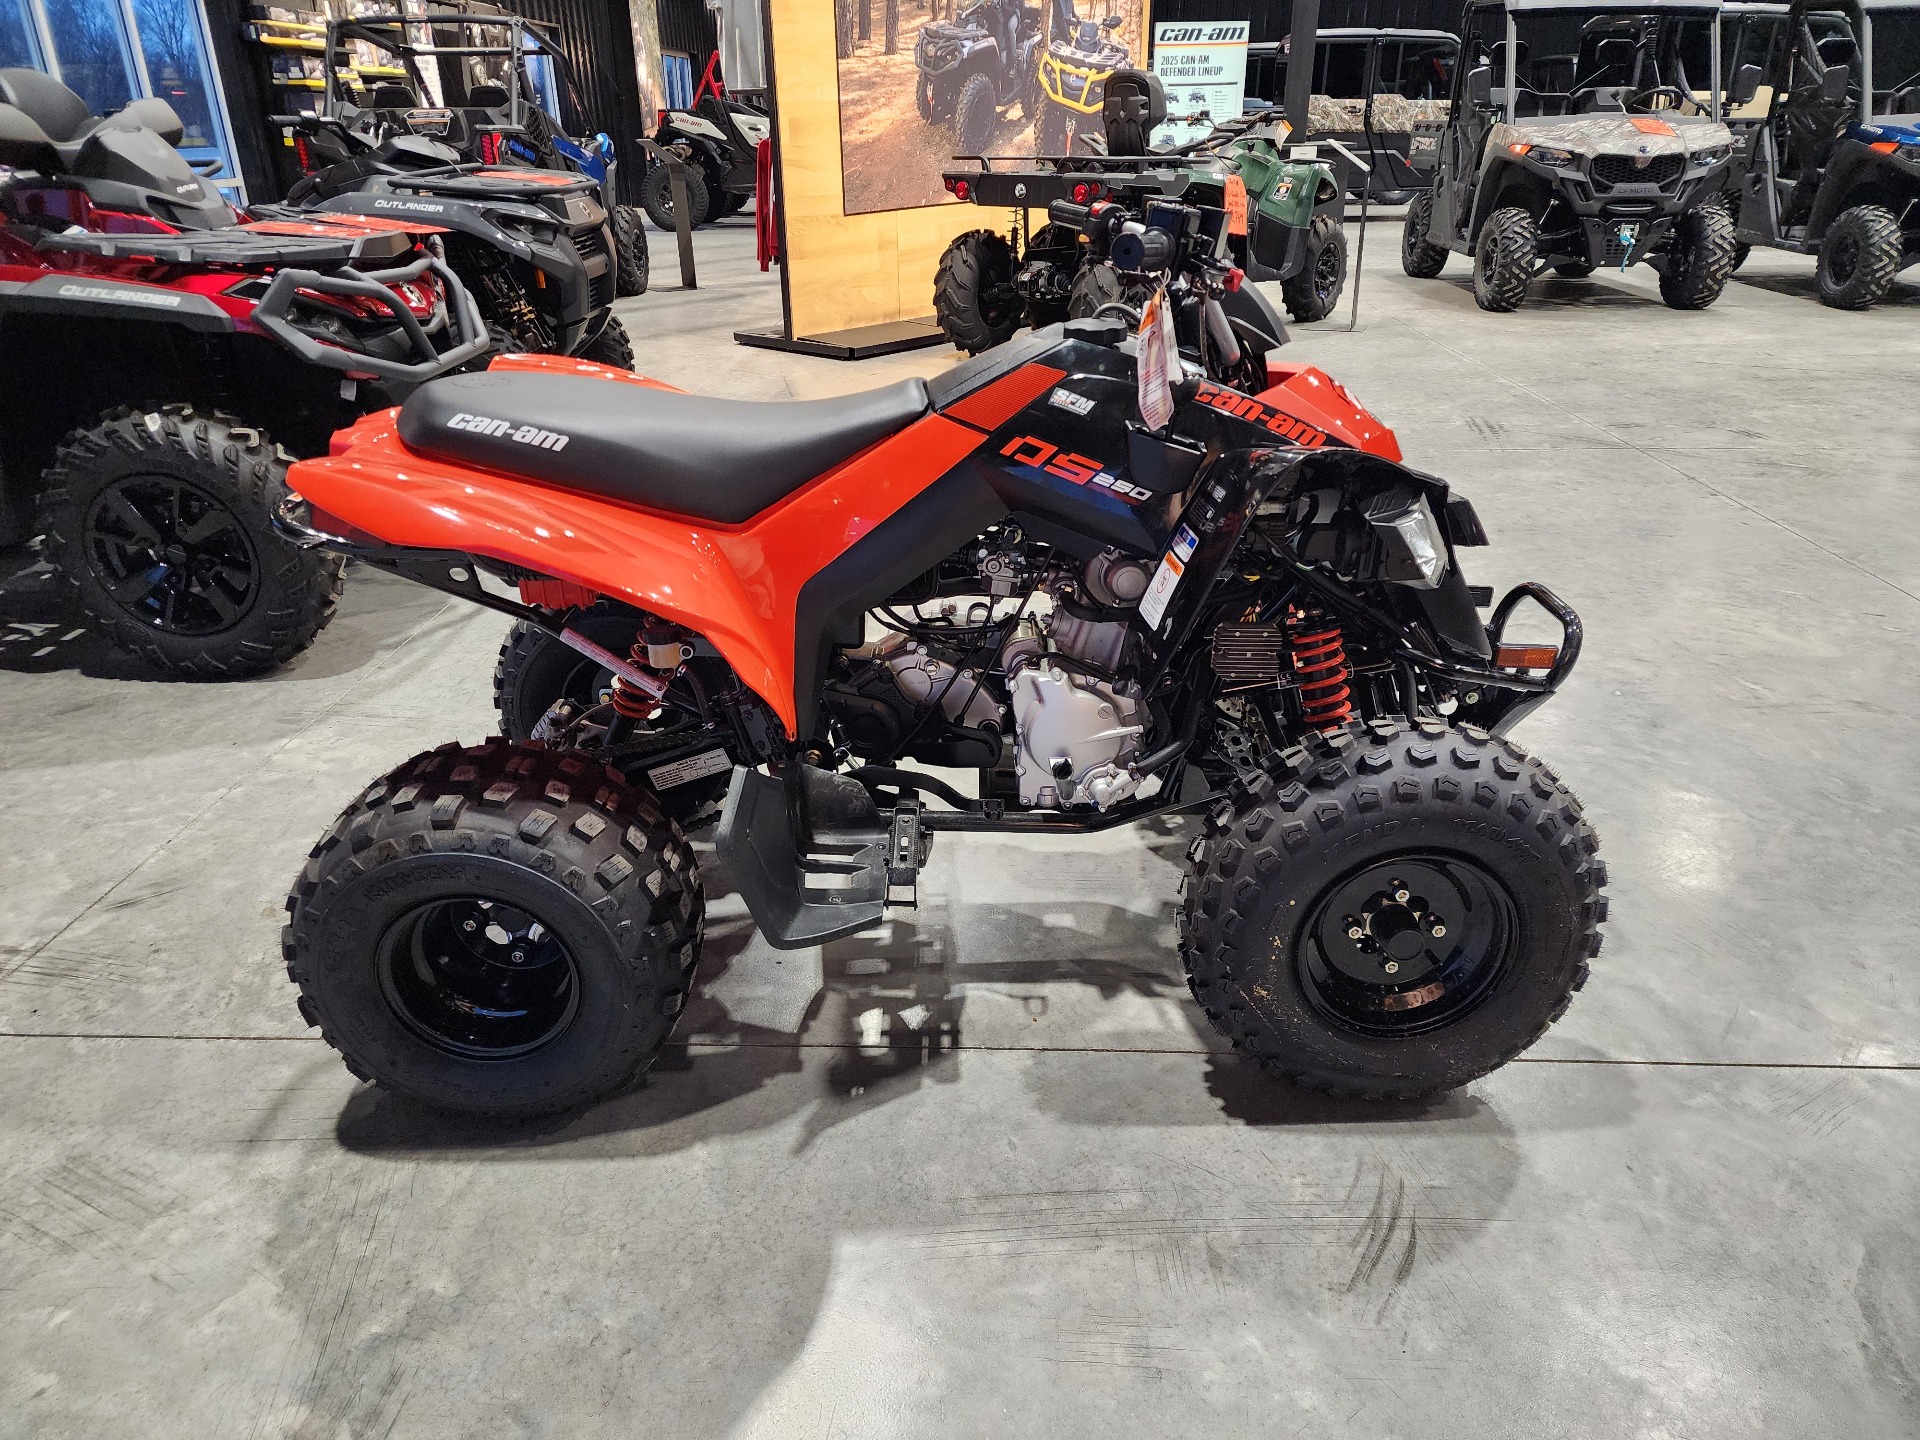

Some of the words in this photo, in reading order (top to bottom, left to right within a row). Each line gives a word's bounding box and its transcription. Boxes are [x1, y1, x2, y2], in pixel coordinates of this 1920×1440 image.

[1160, 27, 1245, 41] can-am
[1161, 56, 1178, 65] 2025
[1181, 55, 1209, 65] CAN-AM
[1160, 67, 1196, 76] DEFENDER
[1198, 66, 1223, 76] LINEUP
[674, 116, 703, 128] can-am
[509, 139, 536, 161] can-am
[374, 199, 444, 213] OUTLANDER
[58, 284, 181, 307] OUTLANDER
[1194, 381, 1327, 446] can-am
[446, 413, 570, 452] can-am
[1092, 472, 1153, 501] 250
